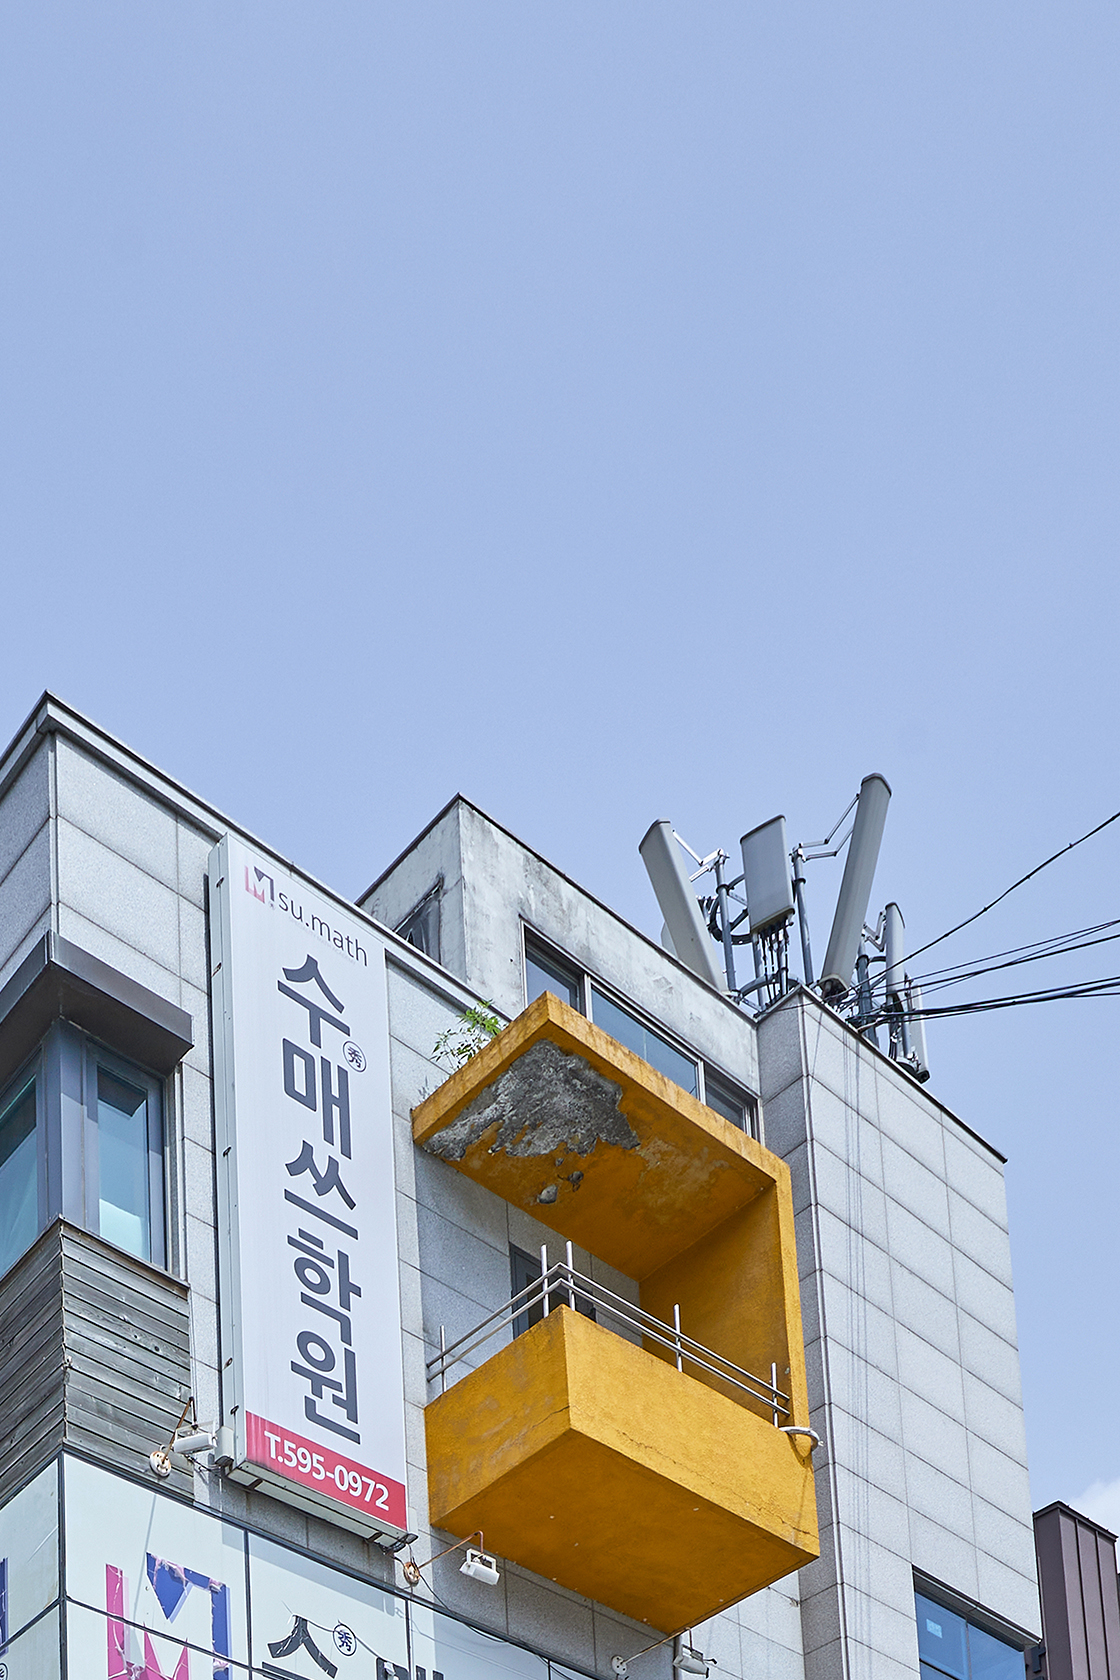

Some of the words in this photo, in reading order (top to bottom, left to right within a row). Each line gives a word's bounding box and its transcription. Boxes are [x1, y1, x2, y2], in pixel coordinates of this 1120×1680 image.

[278, 889, 368, 967] su.math
[276, 953, 363, 1446] 수매쓰학원
[264, 1430, 391, 1512] T.595-0972
